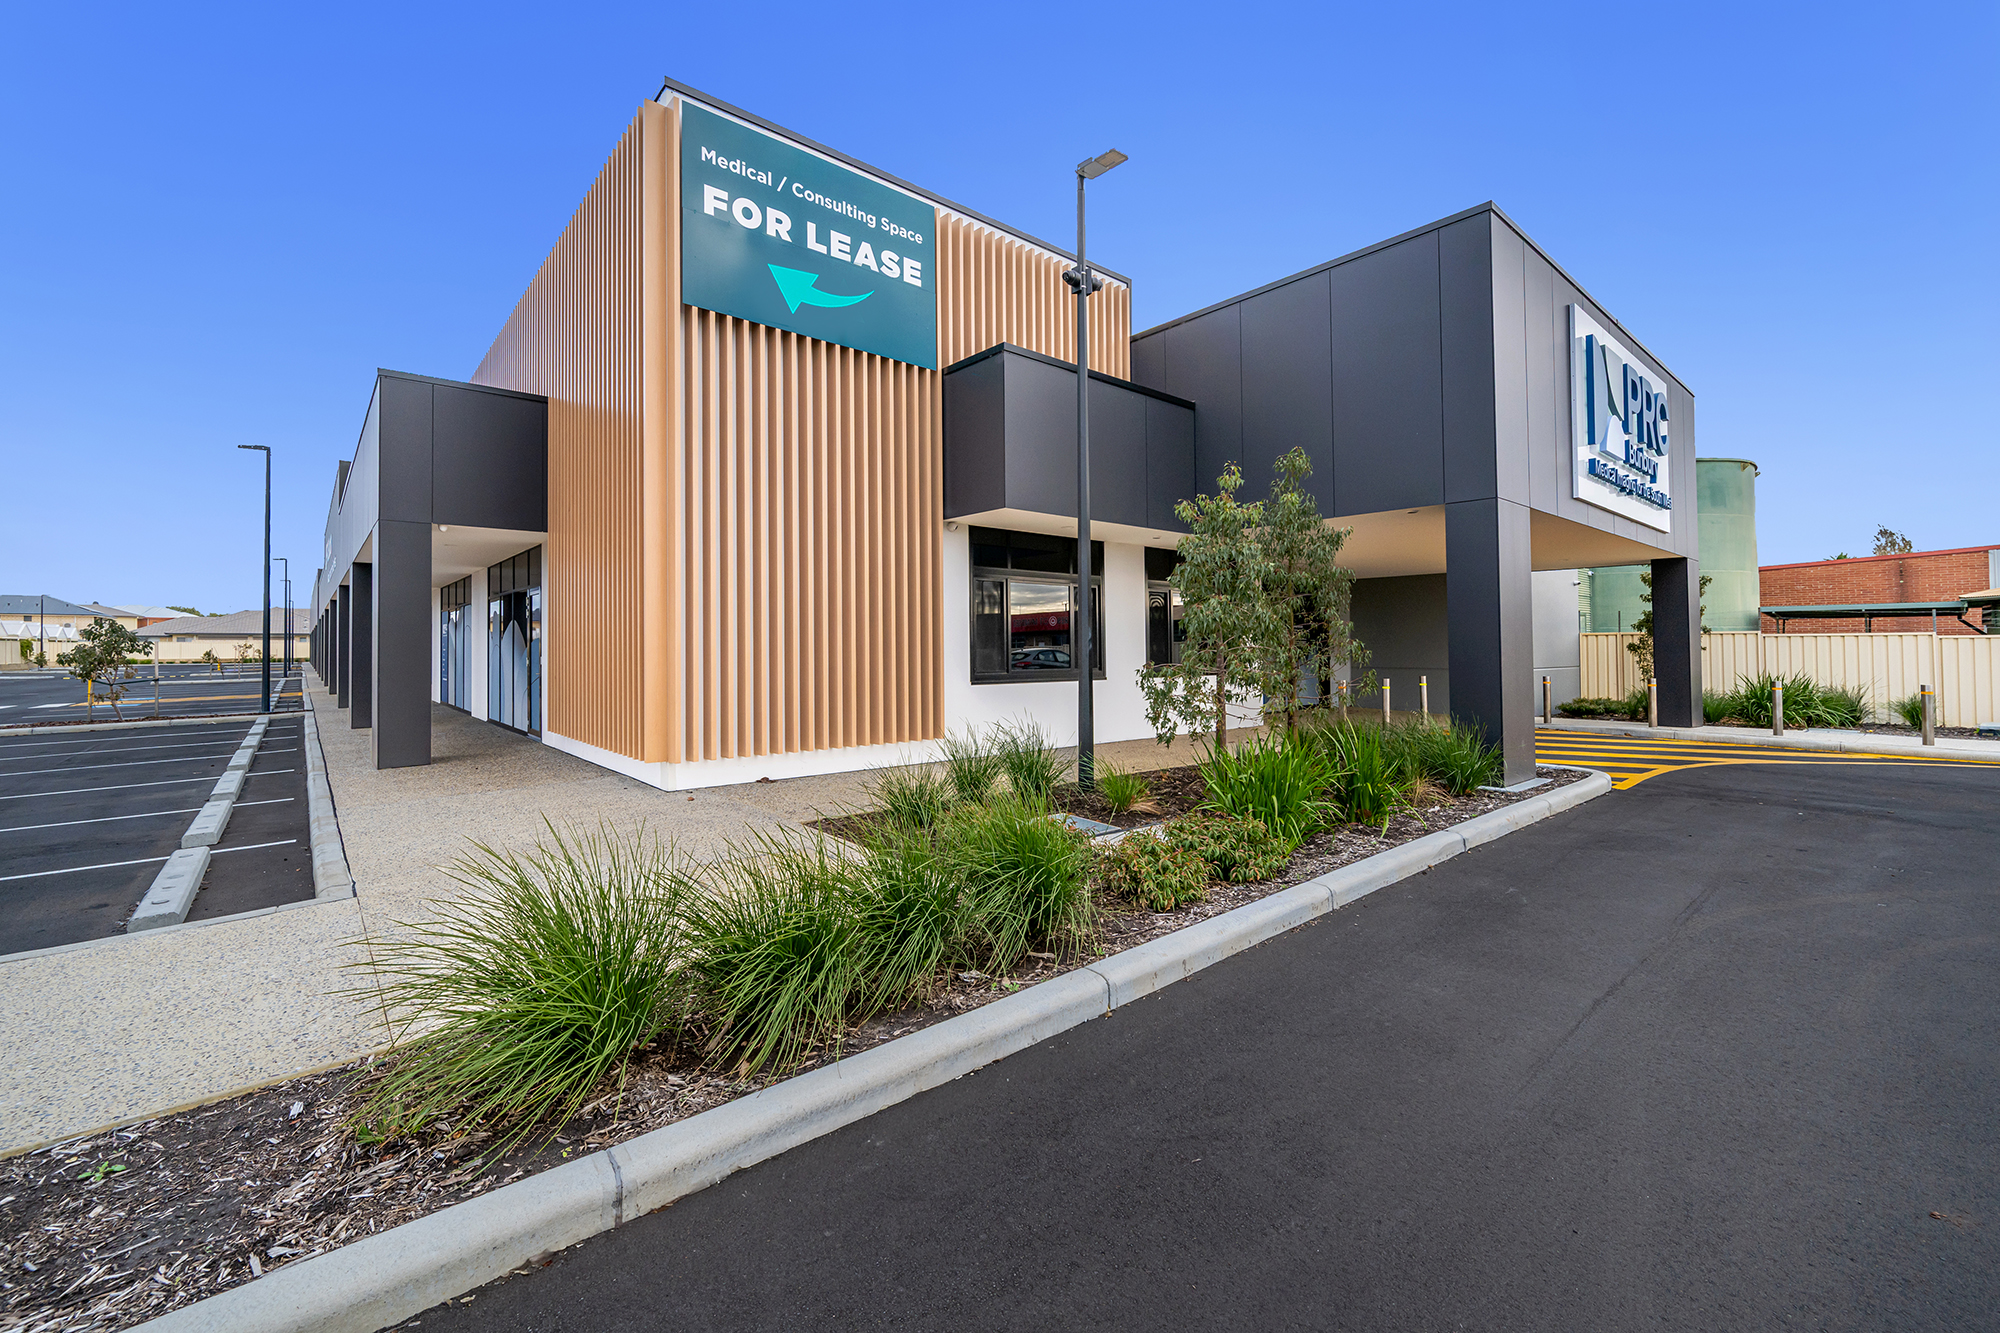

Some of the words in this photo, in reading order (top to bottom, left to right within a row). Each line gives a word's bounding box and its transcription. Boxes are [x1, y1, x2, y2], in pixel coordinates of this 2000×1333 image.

[701, 146, 772, 187] Medical
[776, 176, 788, 192] /
[791, 182, 877, 229] Consulting
[880, 217, 923, 244] Space
[703, 183, 793, 243] FOR
[806, 220, 922, 288] LEASE
[1623, 363, 1669, 456] PRC
[1589, 458, 1617, 485] Medical
[1625, 440, 1658, 484] Bunbury
